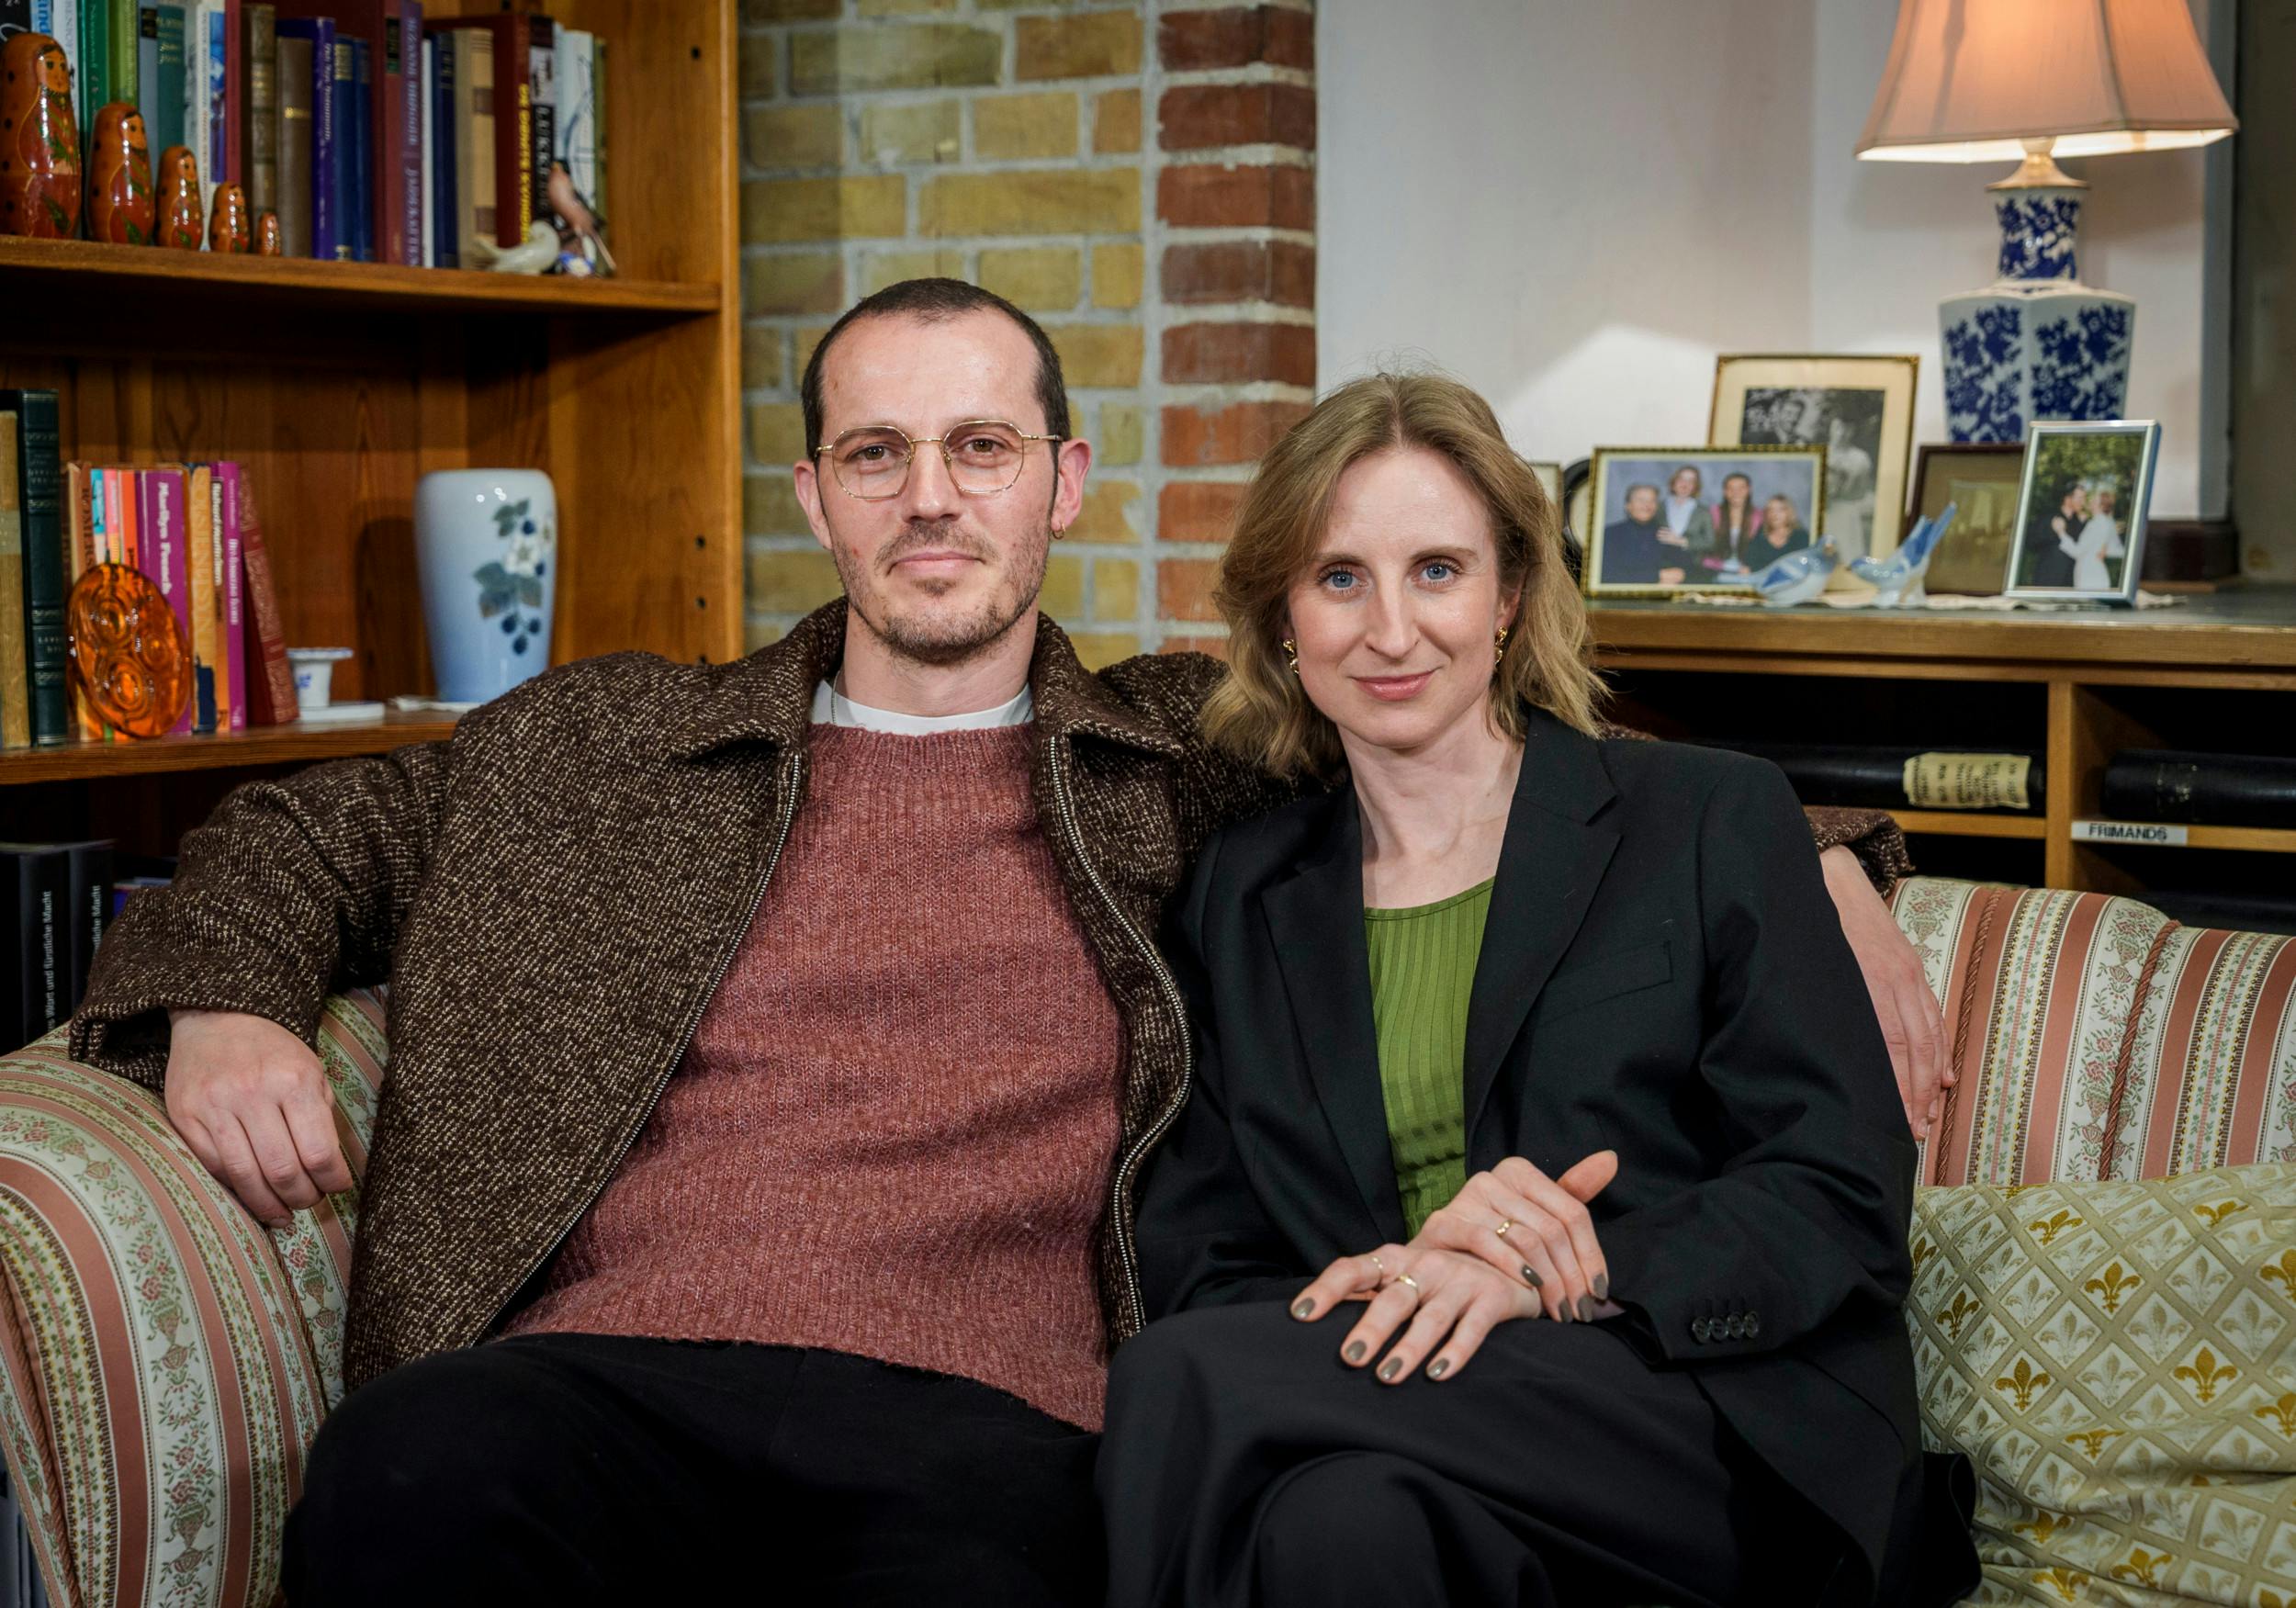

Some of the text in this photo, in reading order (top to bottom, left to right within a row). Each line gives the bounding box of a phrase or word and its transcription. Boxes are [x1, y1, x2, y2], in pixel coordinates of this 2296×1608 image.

[157, 482, 173, 595] Marilyn French
[2088, 823, 2167, 842] FRIMANDS
